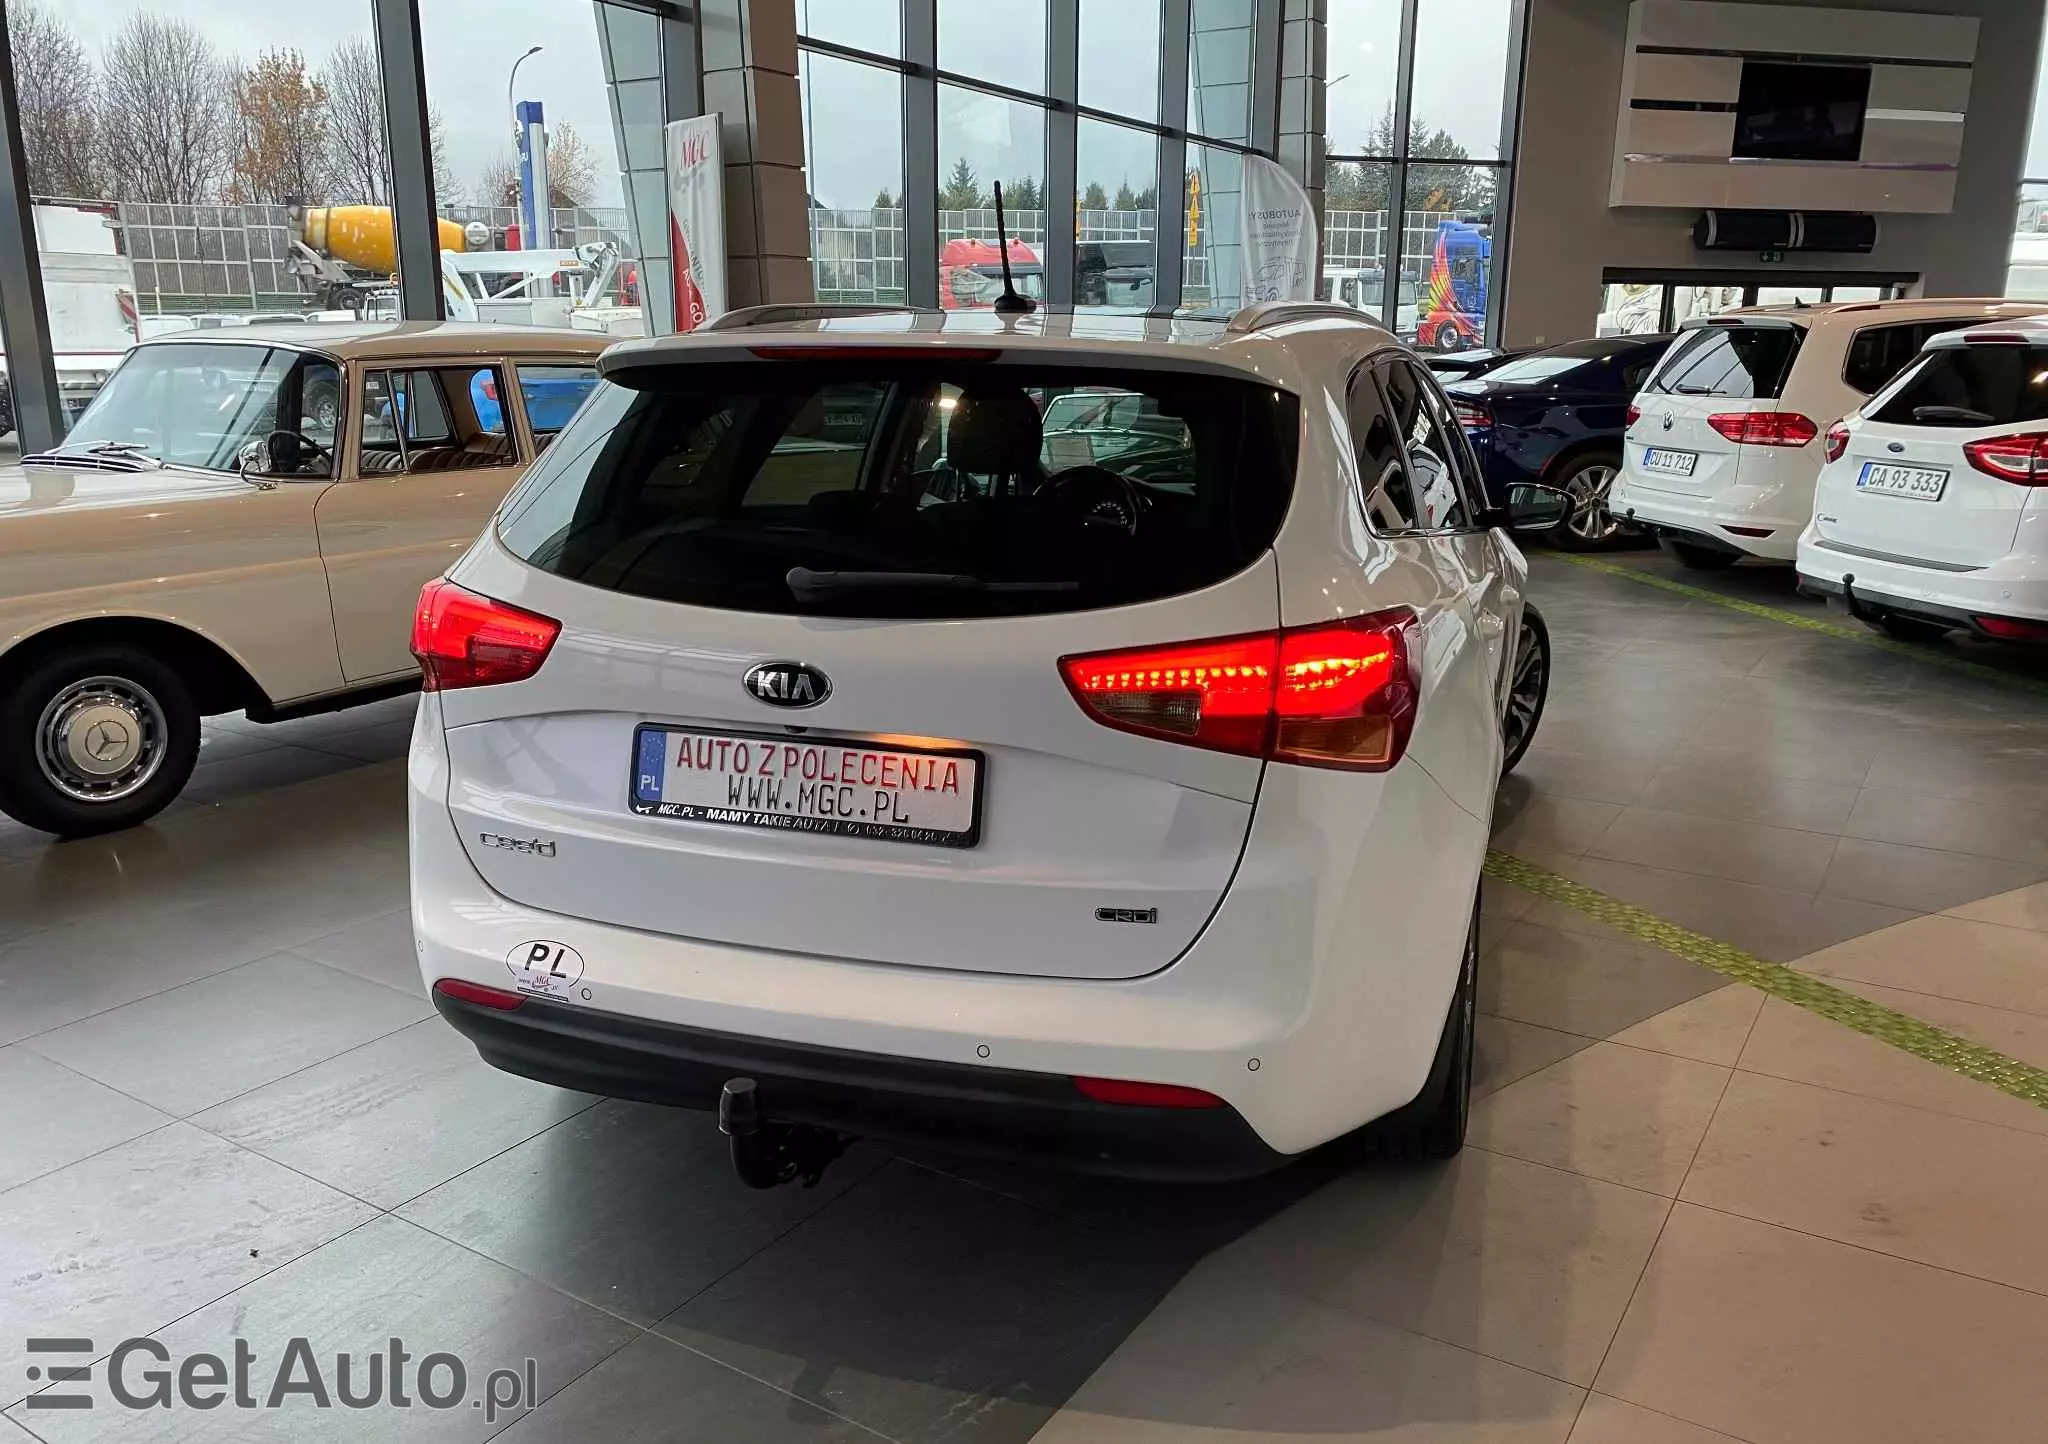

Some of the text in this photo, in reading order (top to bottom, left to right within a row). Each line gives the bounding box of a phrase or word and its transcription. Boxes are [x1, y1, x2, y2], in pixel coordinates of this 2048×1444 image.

[1650, 452, 1693, 470] CU 11 712
[1869, 467, 1888, 487] CA
[1890, 470, 1910, 489] 93
[1911, 471, 1943, 493] 333
[757, 670, 816, 701] KIA
[676, 736, 960, 794] AUTO Z POLECENIA
[640, 774, 660, 792] PL
[727, 774, 910, 824] WWW.MGC.PL
[657, 802, 696, 818] MGC.PL
[705, 808, 751, 825] MAMY
[752, 812, 793, 829] TAKIE
[524, 943, 568, 979] PL
